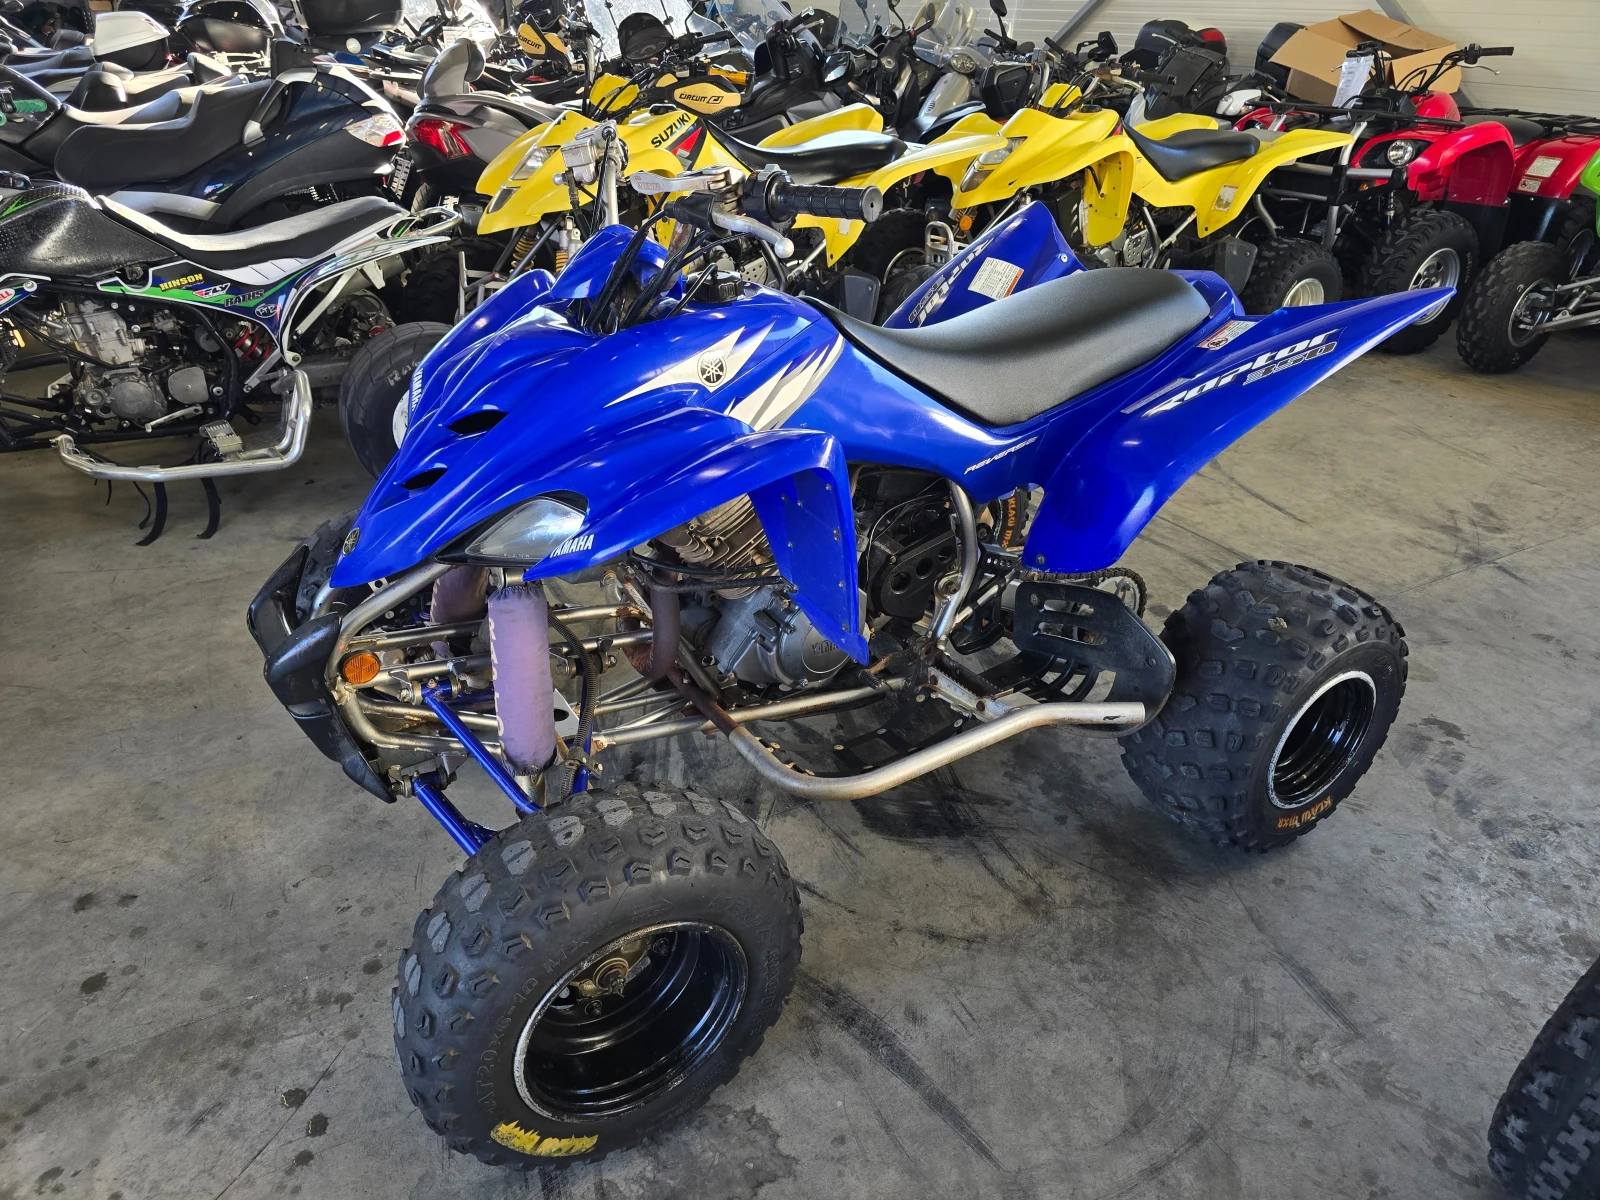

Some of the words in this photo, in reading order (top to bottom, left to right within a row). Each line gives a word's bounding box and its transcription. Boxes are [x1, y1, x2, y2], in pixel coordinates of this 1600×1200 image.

[518, 33, 542, 50] CIRCUIT
[678, 93, 708, 103] CIRCUIT
[650, 112, 692, 148] SUZUKI
[159, 273, 203, 292] HINSON
[199, 283, 231, 299] FLY
[1243, 341, 1338, 386] 350
[963, 436, 1039, 476] REVERSE
[1007, 497, 1017, 527] KLAW
[1301, 794, 1333, 824] KLAW
